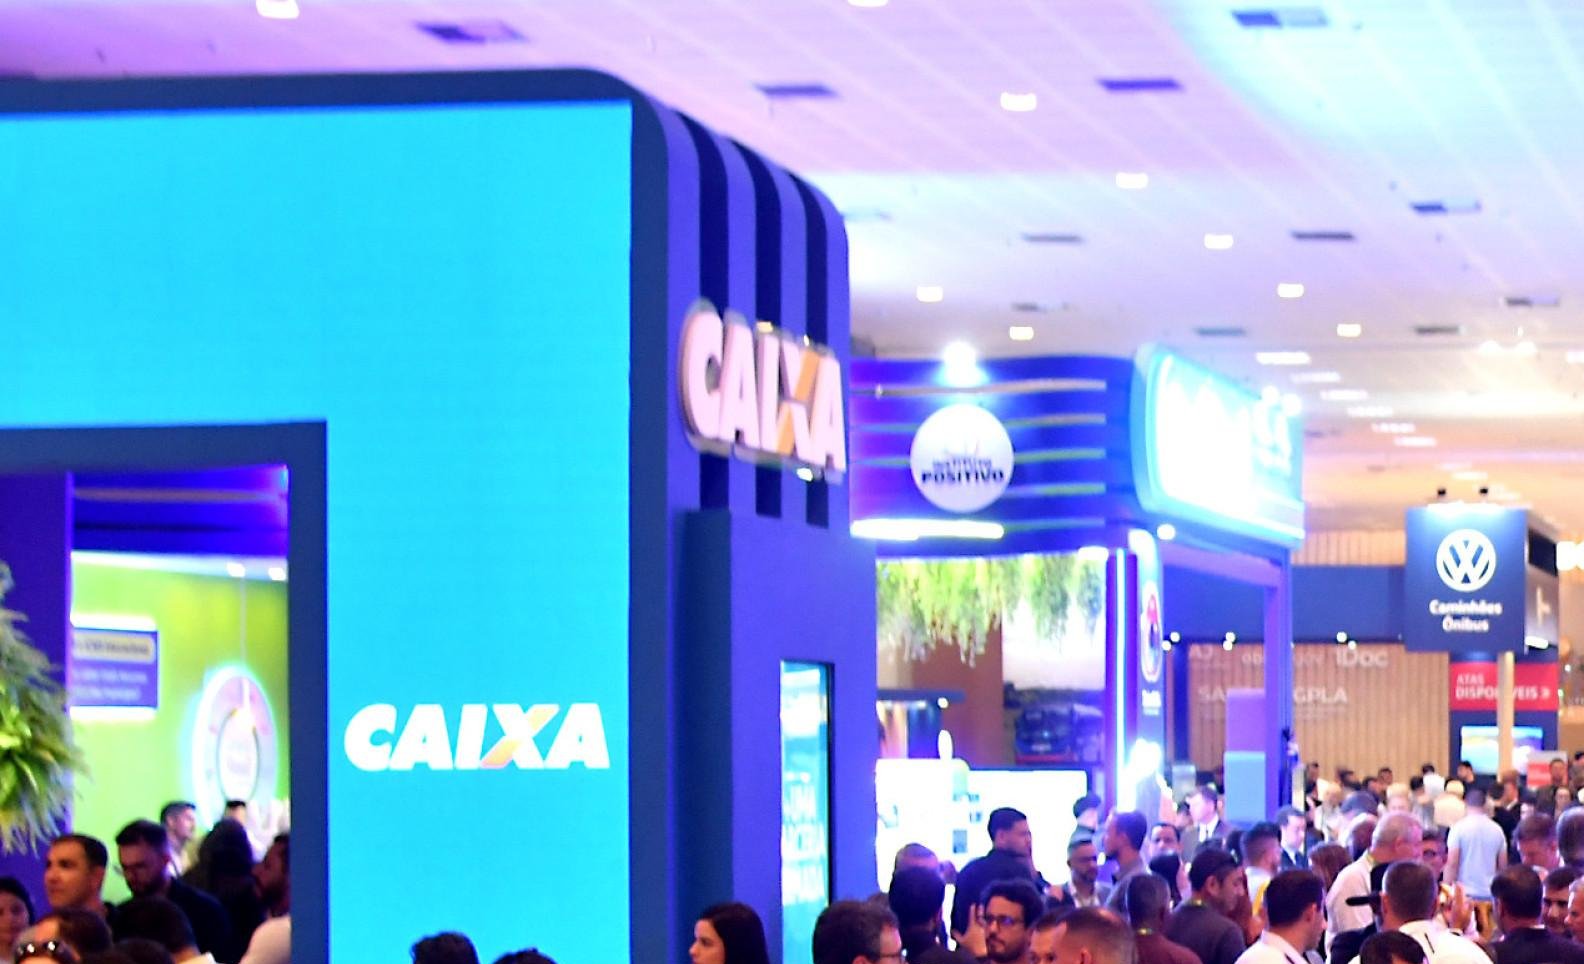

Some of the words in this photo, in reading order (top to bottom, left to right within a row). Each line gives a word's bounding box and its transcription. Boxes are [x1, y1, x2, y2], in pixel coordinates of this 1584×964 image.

[681, 300, 847, 477] CAIXA
[921, 468, 1005, 485] POSITIVO
[1455, 685, 1538, 700] DISPOVEIS
[344, 703, 611, 771] CAIXA
